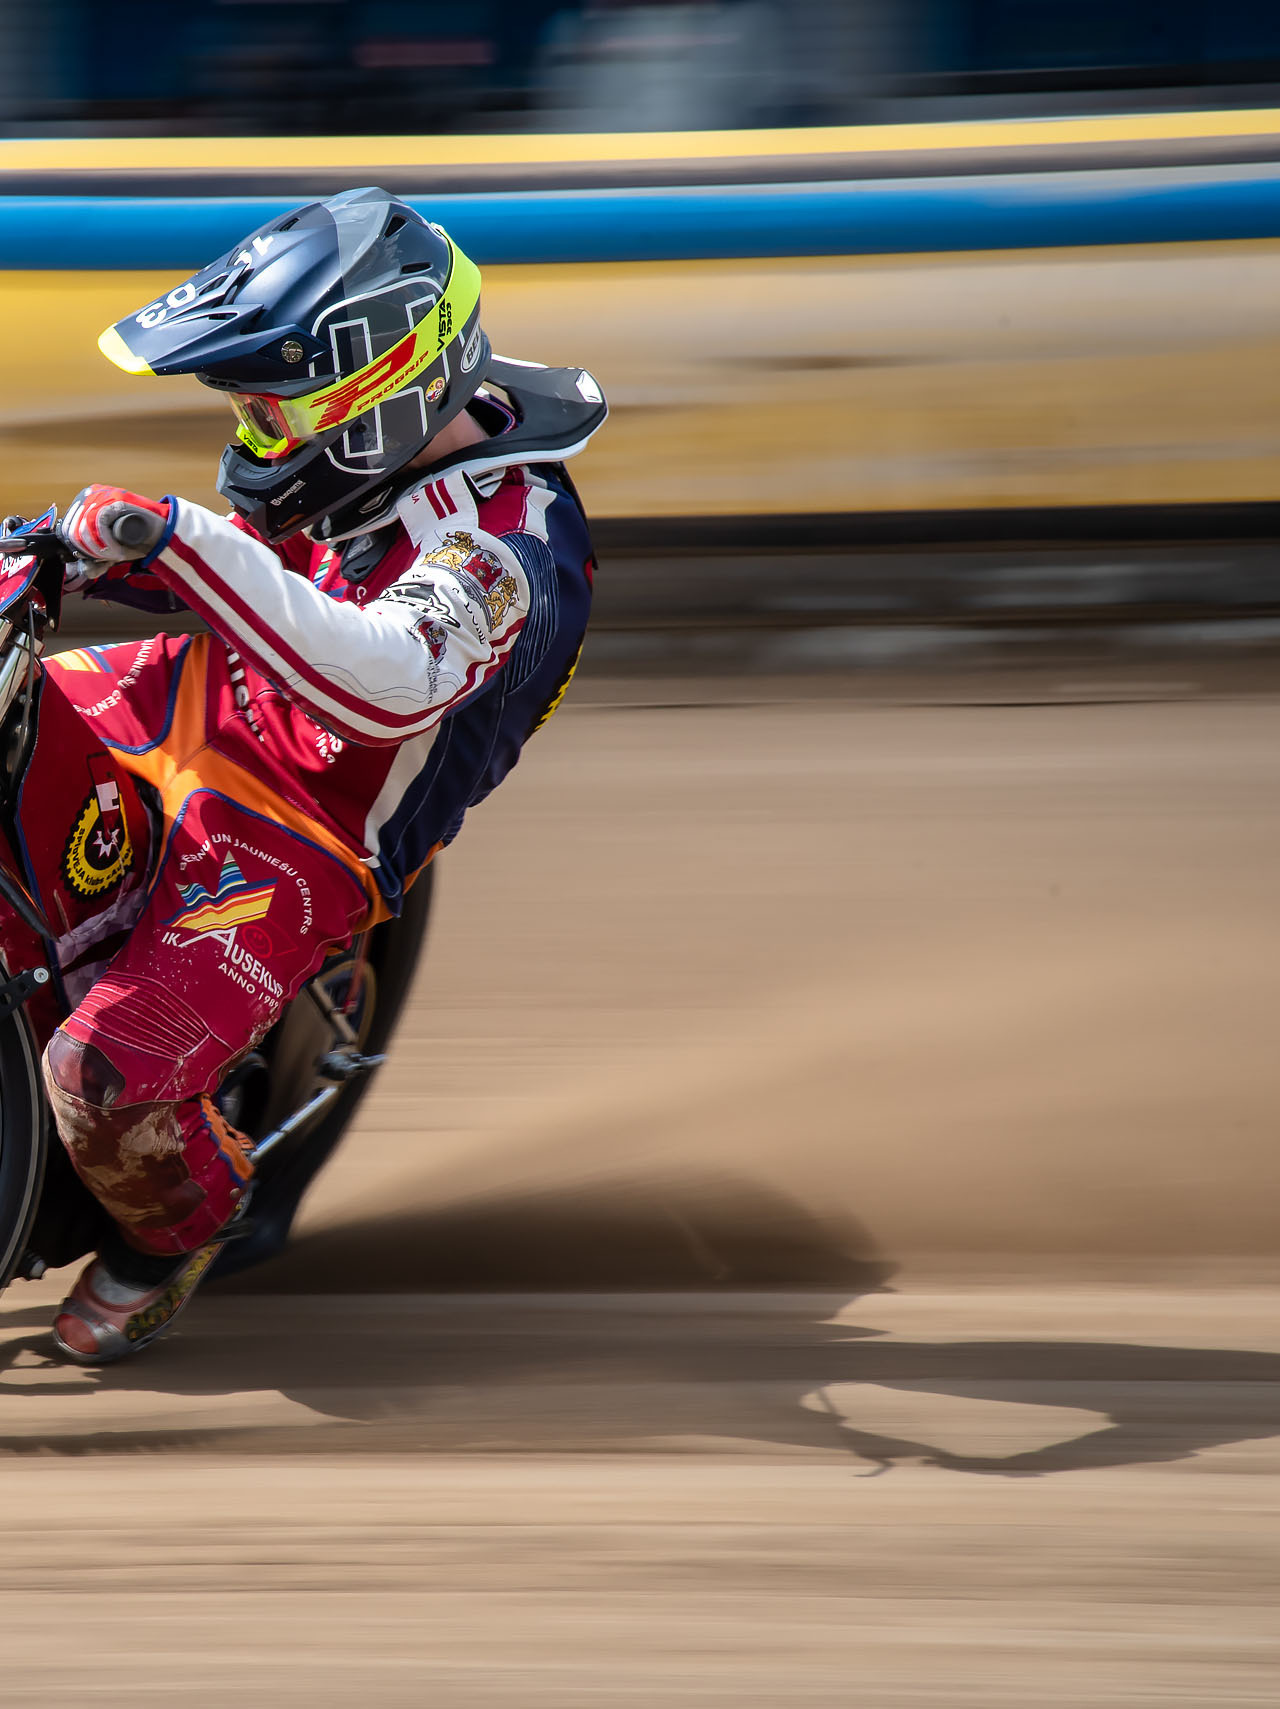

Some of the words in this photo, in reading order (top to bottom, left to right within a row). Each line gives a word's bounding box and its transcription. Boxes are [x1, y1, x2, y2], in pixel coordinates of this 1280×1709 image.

[437, 298, 446, 352] VISTA
[357, 350, 429, 411] PROGRIP
[211, 833, 232, 844] UN
[295, 877, 313, 935] CENTRS
[161, 931, 181, 947] IK
[218, 962, 256, 994] ANNO
